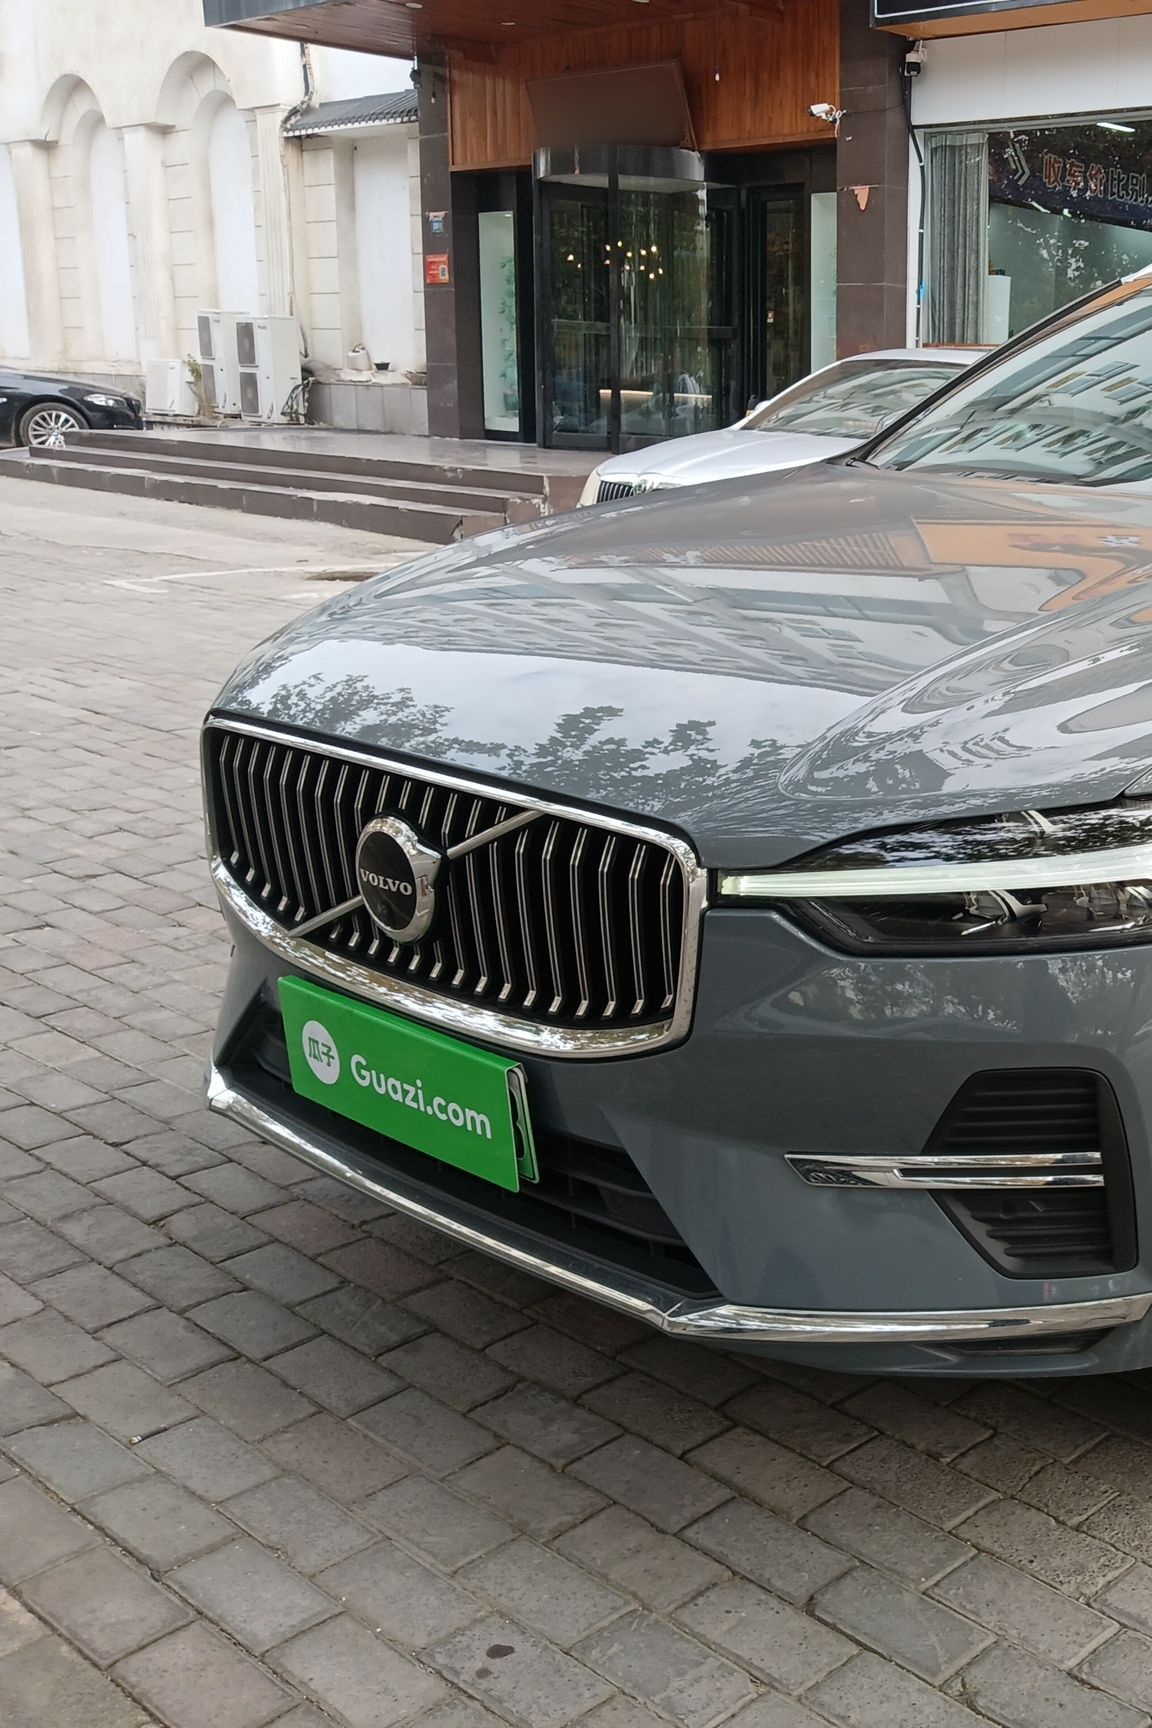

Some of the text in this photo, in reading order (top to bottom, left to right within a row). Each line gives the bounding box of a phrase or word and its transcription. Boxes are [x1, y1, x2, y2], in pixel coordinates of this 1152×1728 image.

[360, 868, 412, 896] VOLVO
[308, 1036, 336, 1067] 瓜子
[350, 1054, 492, 1140] Guazi.com
